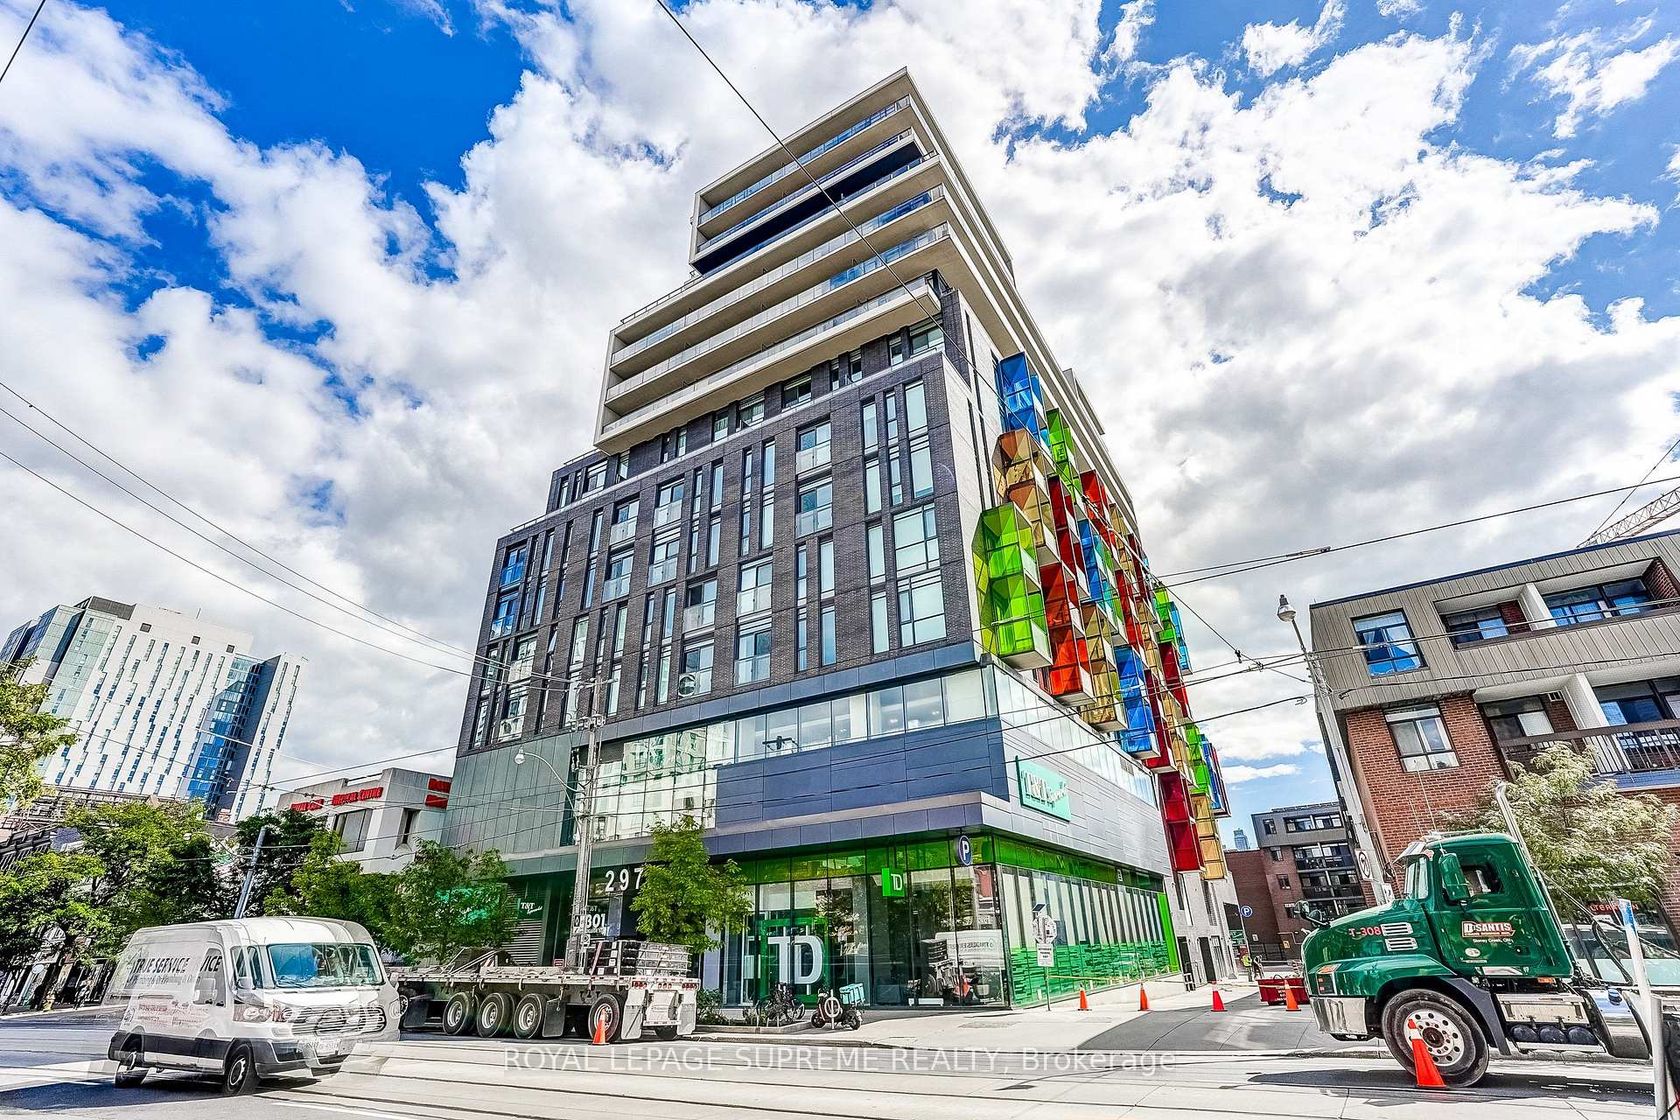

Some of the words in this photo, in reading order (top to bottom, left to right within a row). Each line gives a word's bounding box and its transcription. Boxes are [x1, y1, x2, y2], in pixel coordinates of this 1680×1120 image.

[890, 873, 903, 891] TD
[520, 902, 536, 910] T&T
[1348, 925, 1382, 937] T-308
[768, 935, 823, 985] TD
